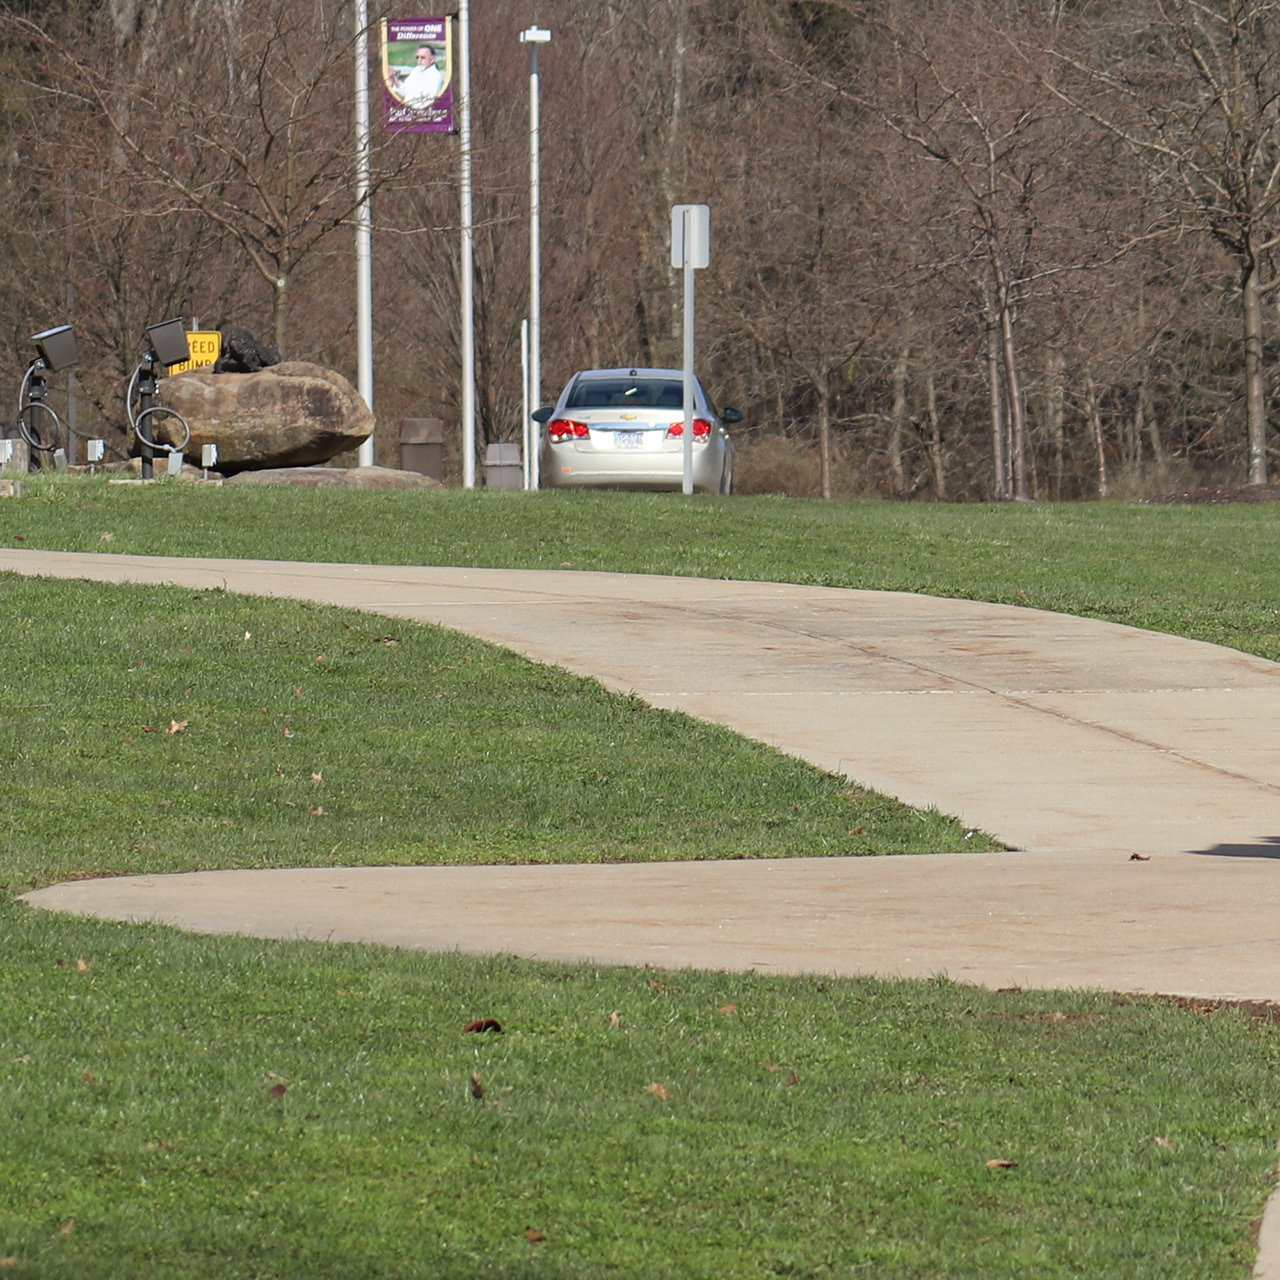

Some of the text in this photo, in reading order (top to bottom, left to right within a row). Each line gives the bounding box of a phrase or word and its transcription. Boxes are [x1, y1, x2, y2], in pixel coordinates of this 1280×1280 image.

[424, 23, 443, 33] ONE
[396, 31, 438, 40] Difference
[188, 339, 216, 354] EED
